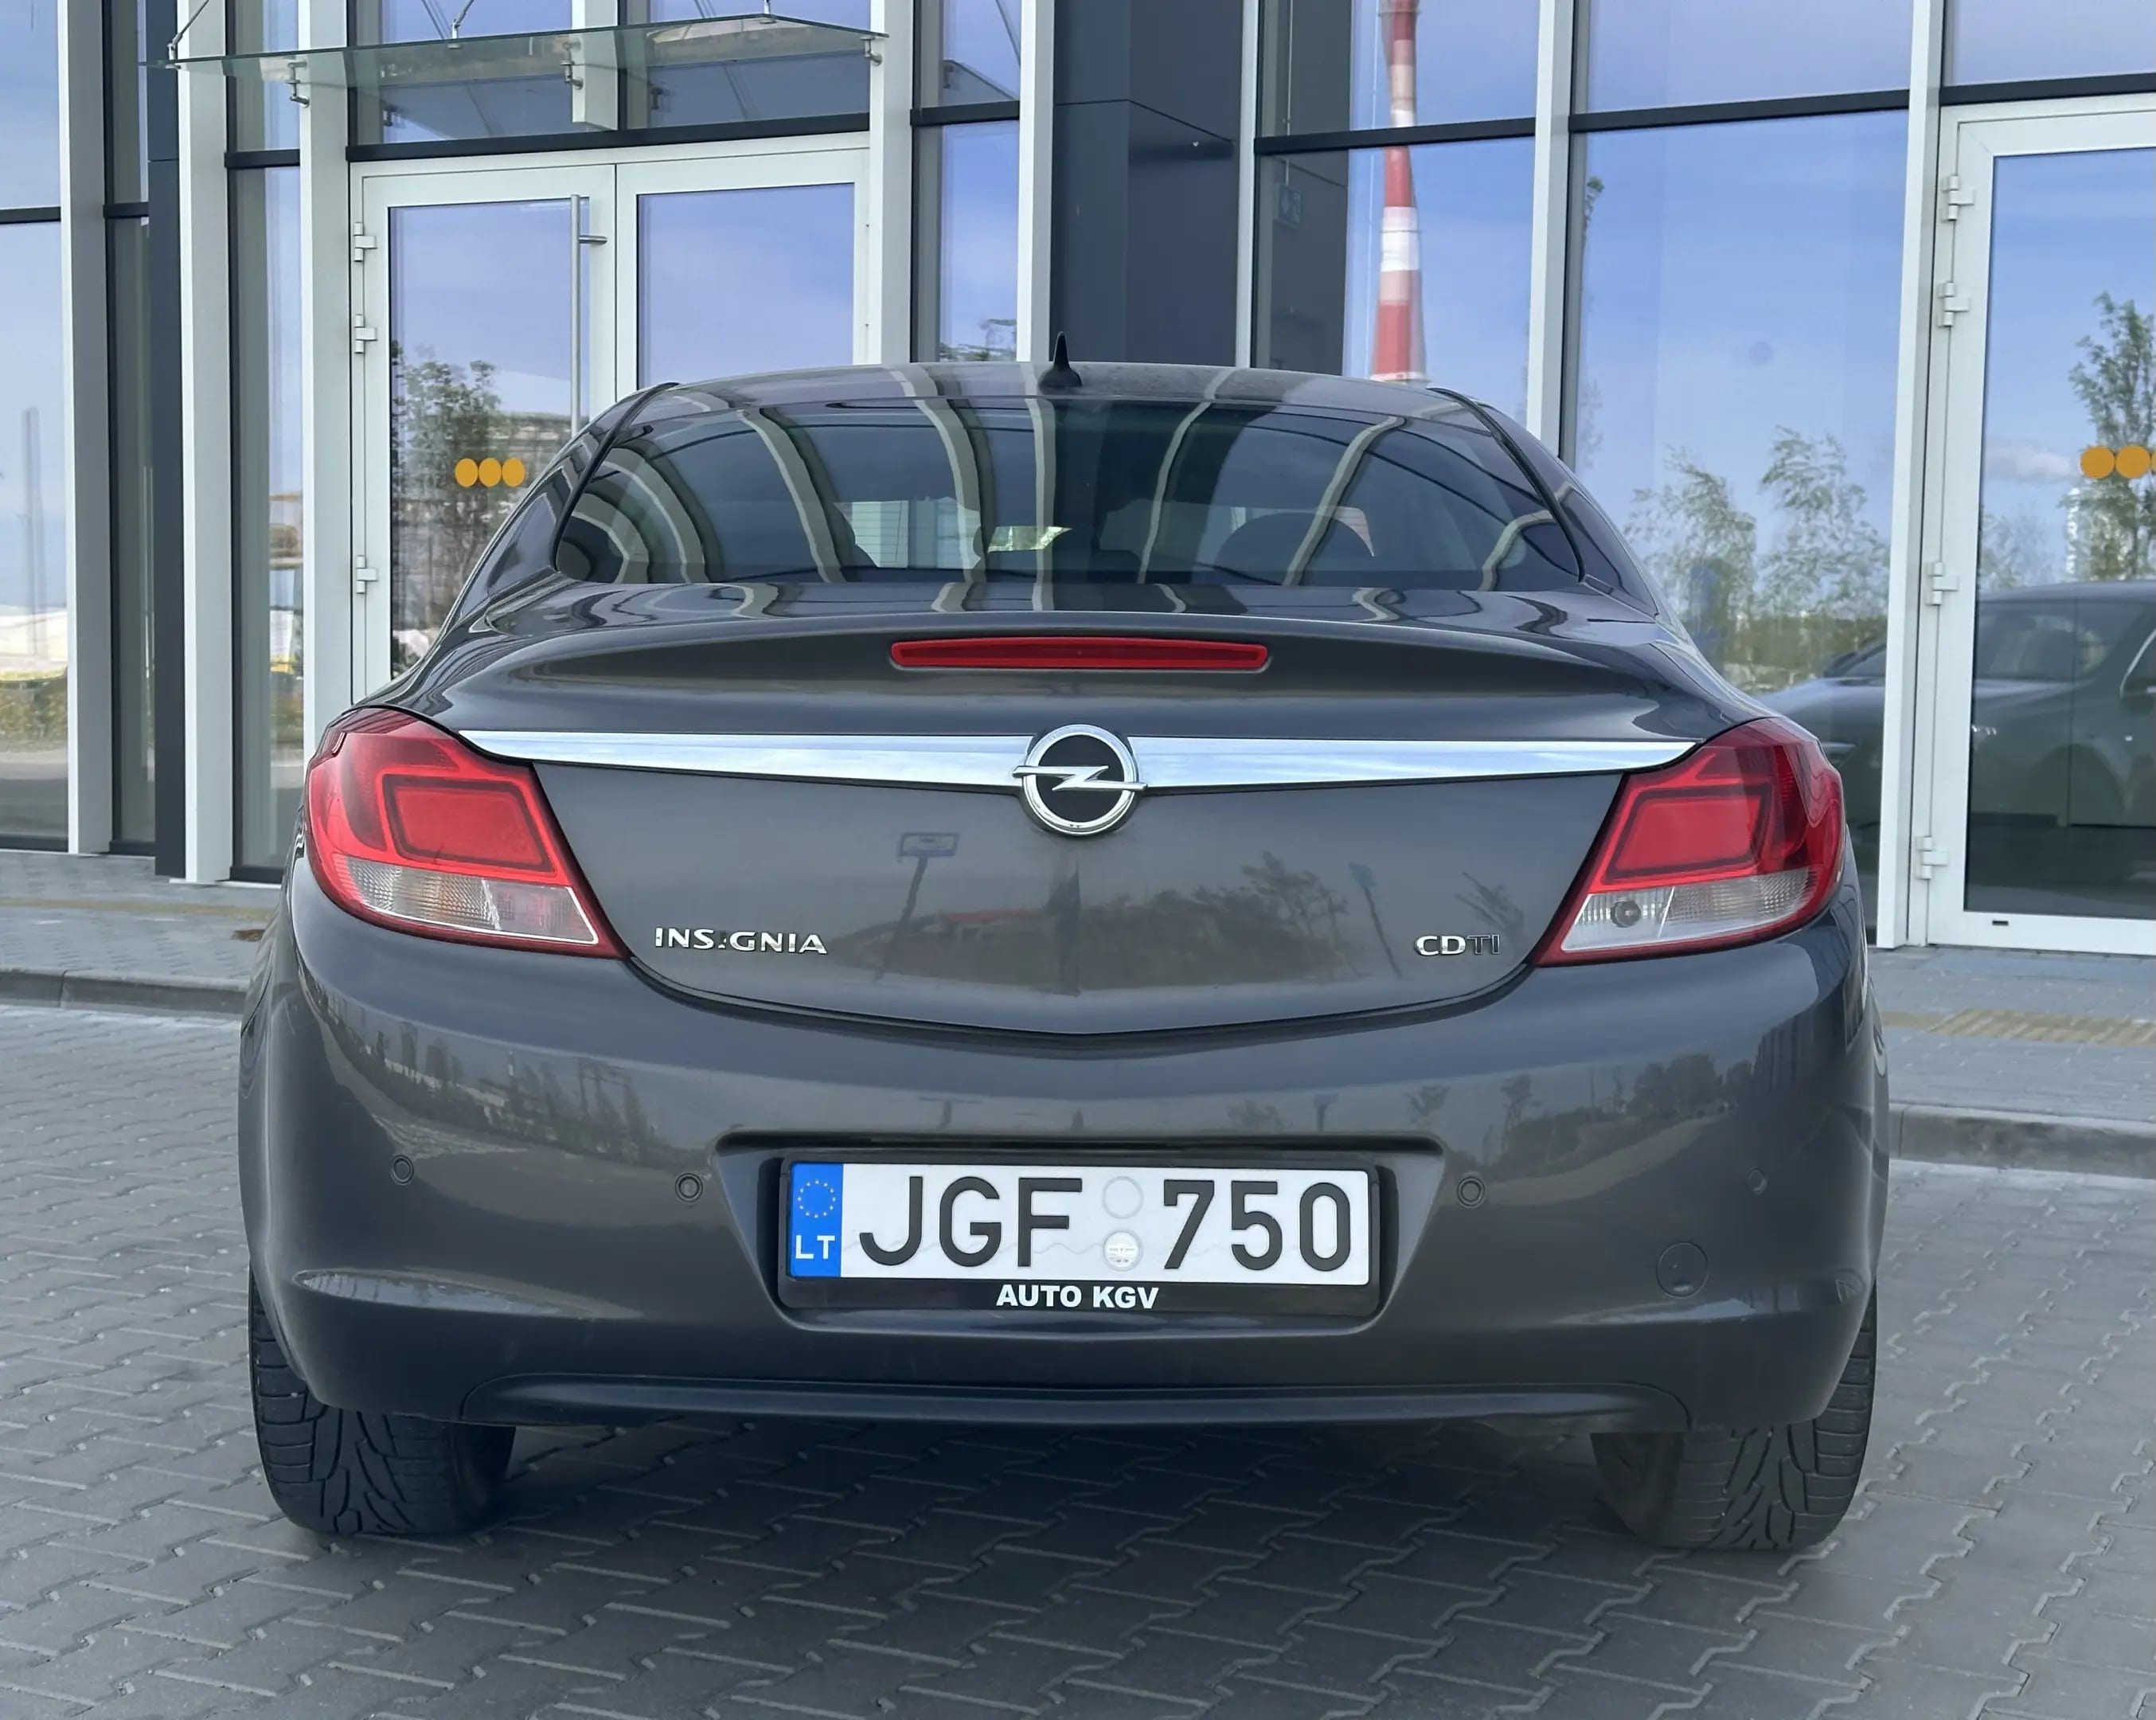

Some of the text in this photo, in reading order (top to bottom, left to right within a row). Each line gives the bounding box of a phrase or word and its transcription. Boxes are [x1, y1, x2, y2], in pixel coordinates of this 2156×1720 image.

[1415, 934, 1501, 956] CDTI
[859, 1175, 1351, 1272] JGF 750
[795, 1234, 836, 1260] LT
[995, 1284, 1160, 1309] AUTO KGV
